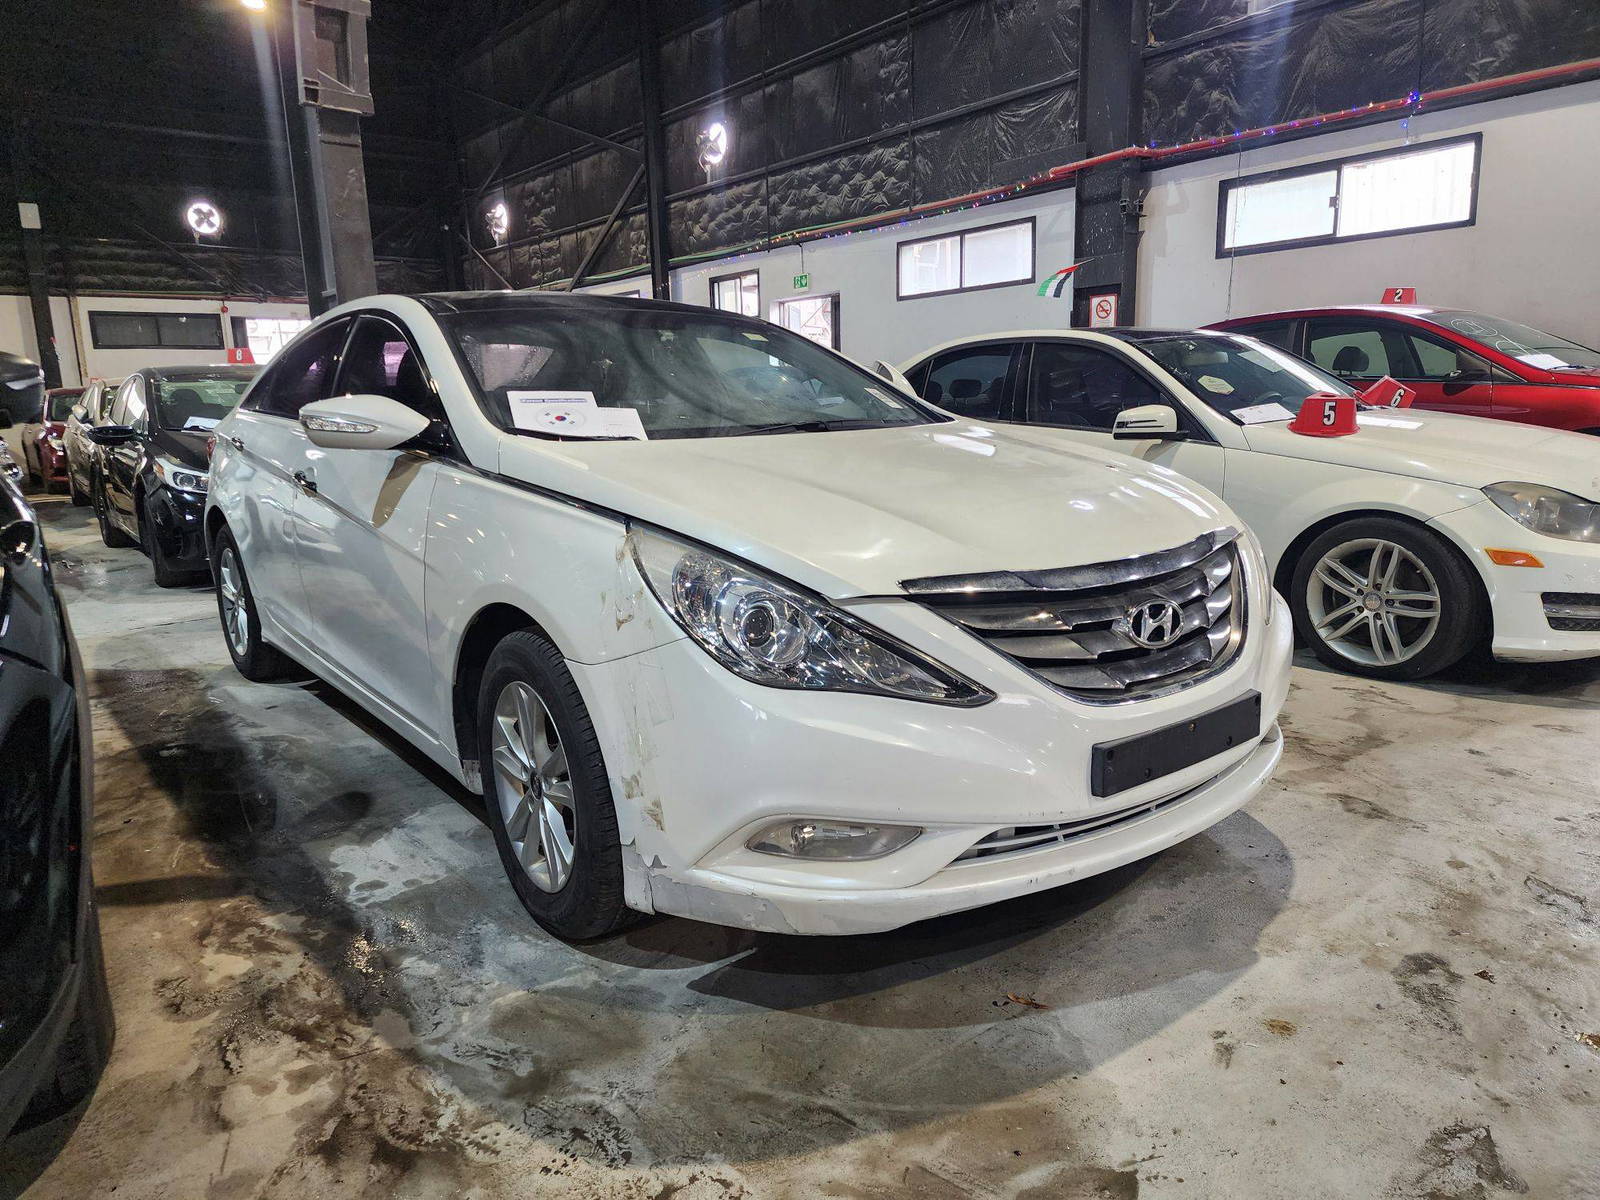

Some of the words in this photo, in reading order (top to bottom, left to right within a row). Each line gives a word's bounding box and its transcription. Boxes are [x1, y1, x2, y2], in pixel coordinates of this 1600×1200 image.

[1394, 288, 1403, 302] 2
[236, 349, 243, 361] 8
[1390, 388, 1405, 408] 6
[1322, 401, 1336, 426] 5
